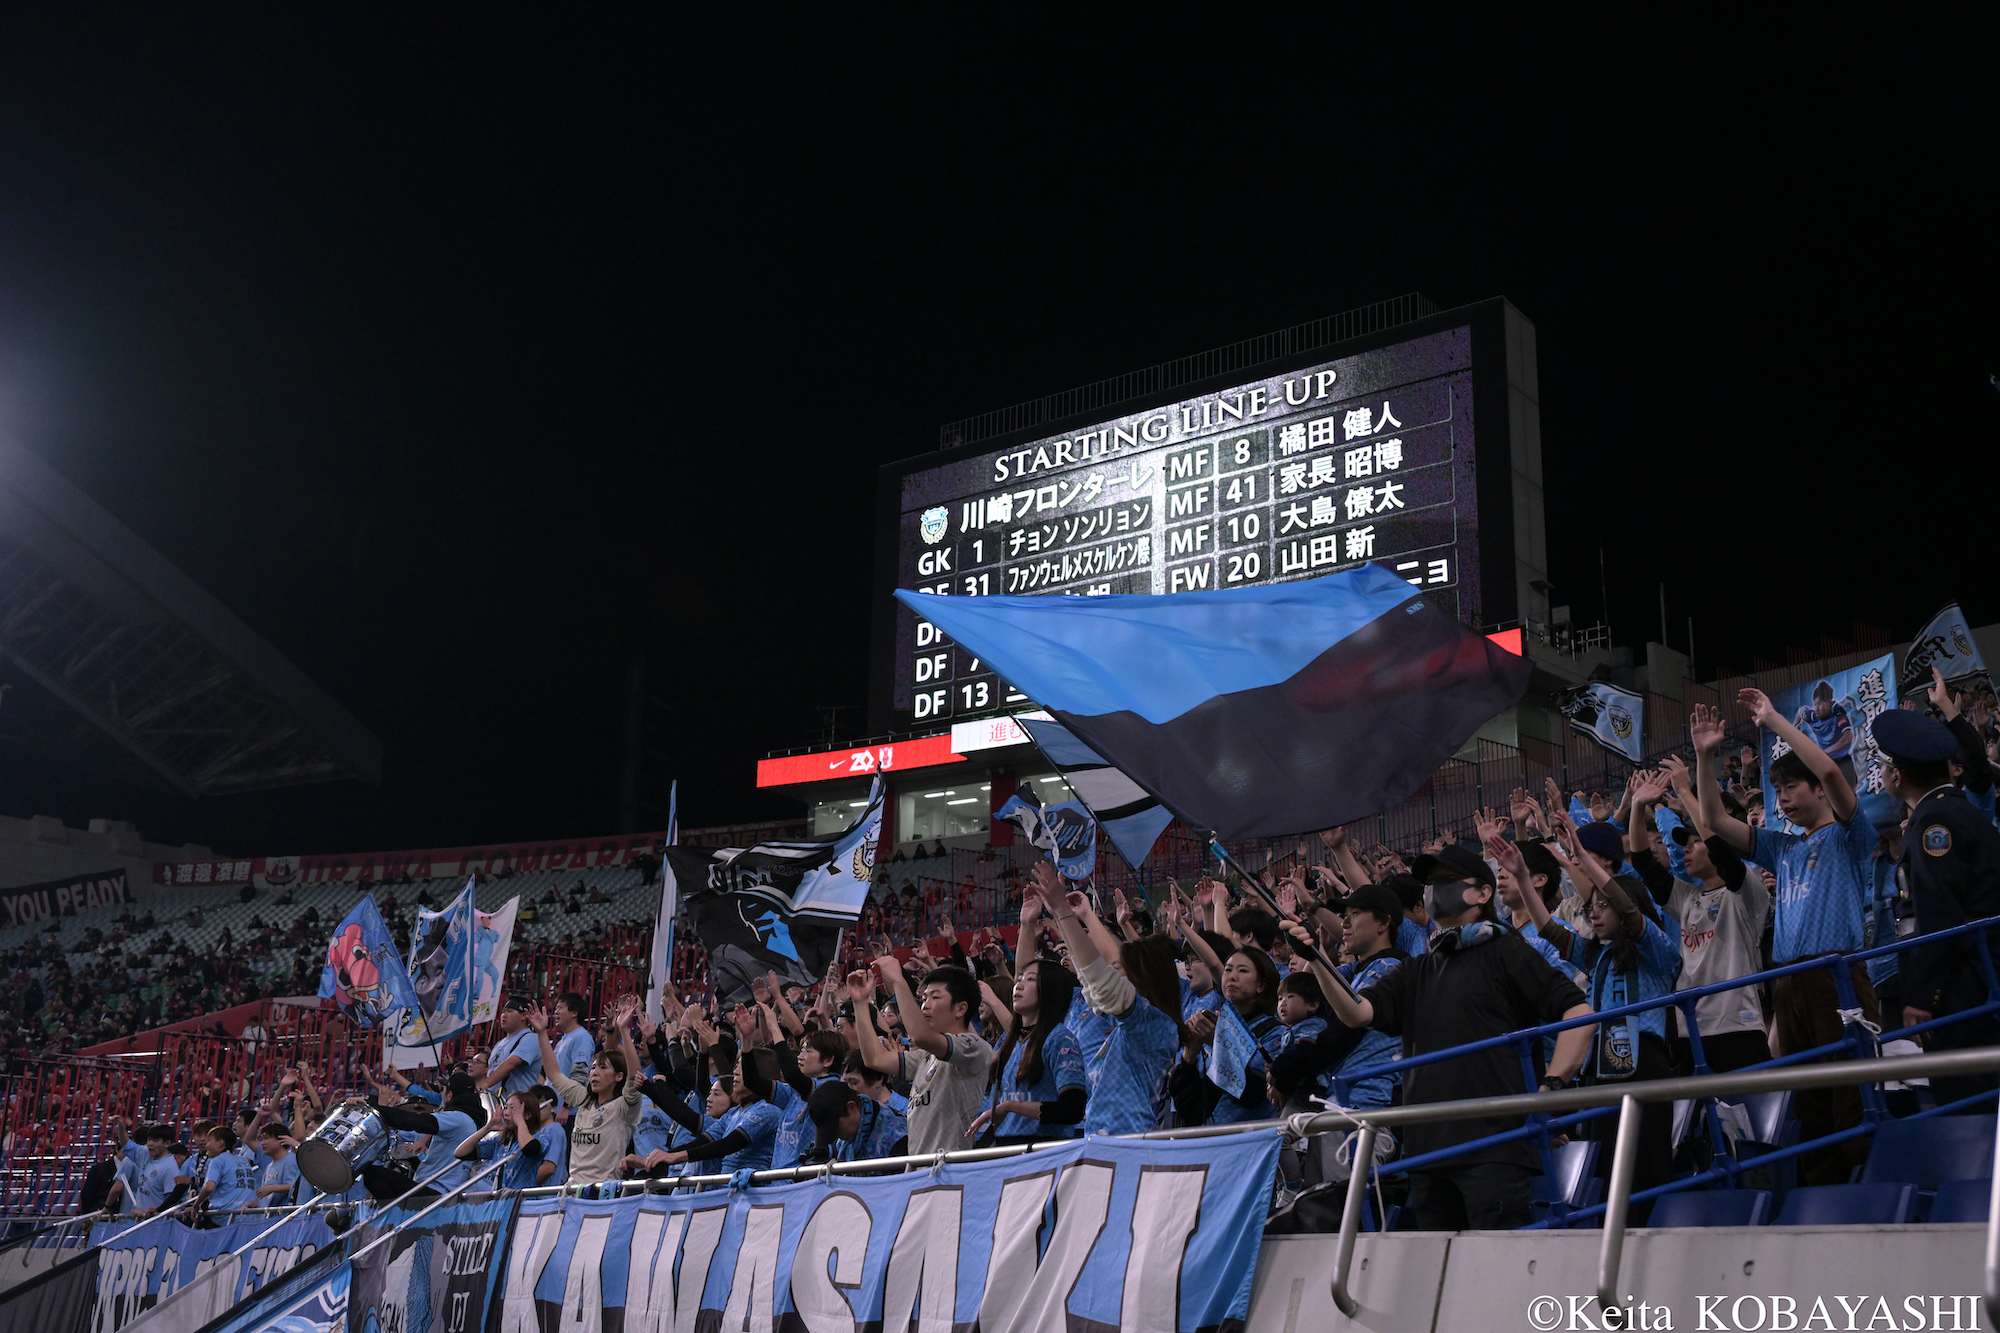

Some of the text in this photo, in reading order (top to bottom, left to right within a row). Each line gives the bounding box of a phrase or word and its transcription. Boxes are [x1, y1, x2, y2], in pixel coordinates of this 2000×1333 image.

[993, 369, 1337, 483] STARTING LINE-UP
[1169, 400, 1402, 481] MF 8 橘田 健人
[960, 461, 1155, 533] 川崎フロンターレ
[1169, 439, 1404, 519] MF 41 家長 昭博
[917, 503, 1150, 576] GK 1 チョン ソンリョン
[1169, 481, 1405, 557] MF 10 大島 僚太
[964, 573, 990, 597] 31
[1008, 535, 1151, 593] ファンウェルメスケルケン際
[1170, 525, 1376, 594] FW 20 山田 新
[914, 690, 946, 719] DF
[962, 682, 990, 709] 13
[916, 653, 948, 683] DF
[685, 828, 789, 847] ANDIERA
[2, 890, 52, 927] YOU
[442, 1232, 494, 1276] STILE
[501, 1157, 1210, 1333] KAWASAKI
